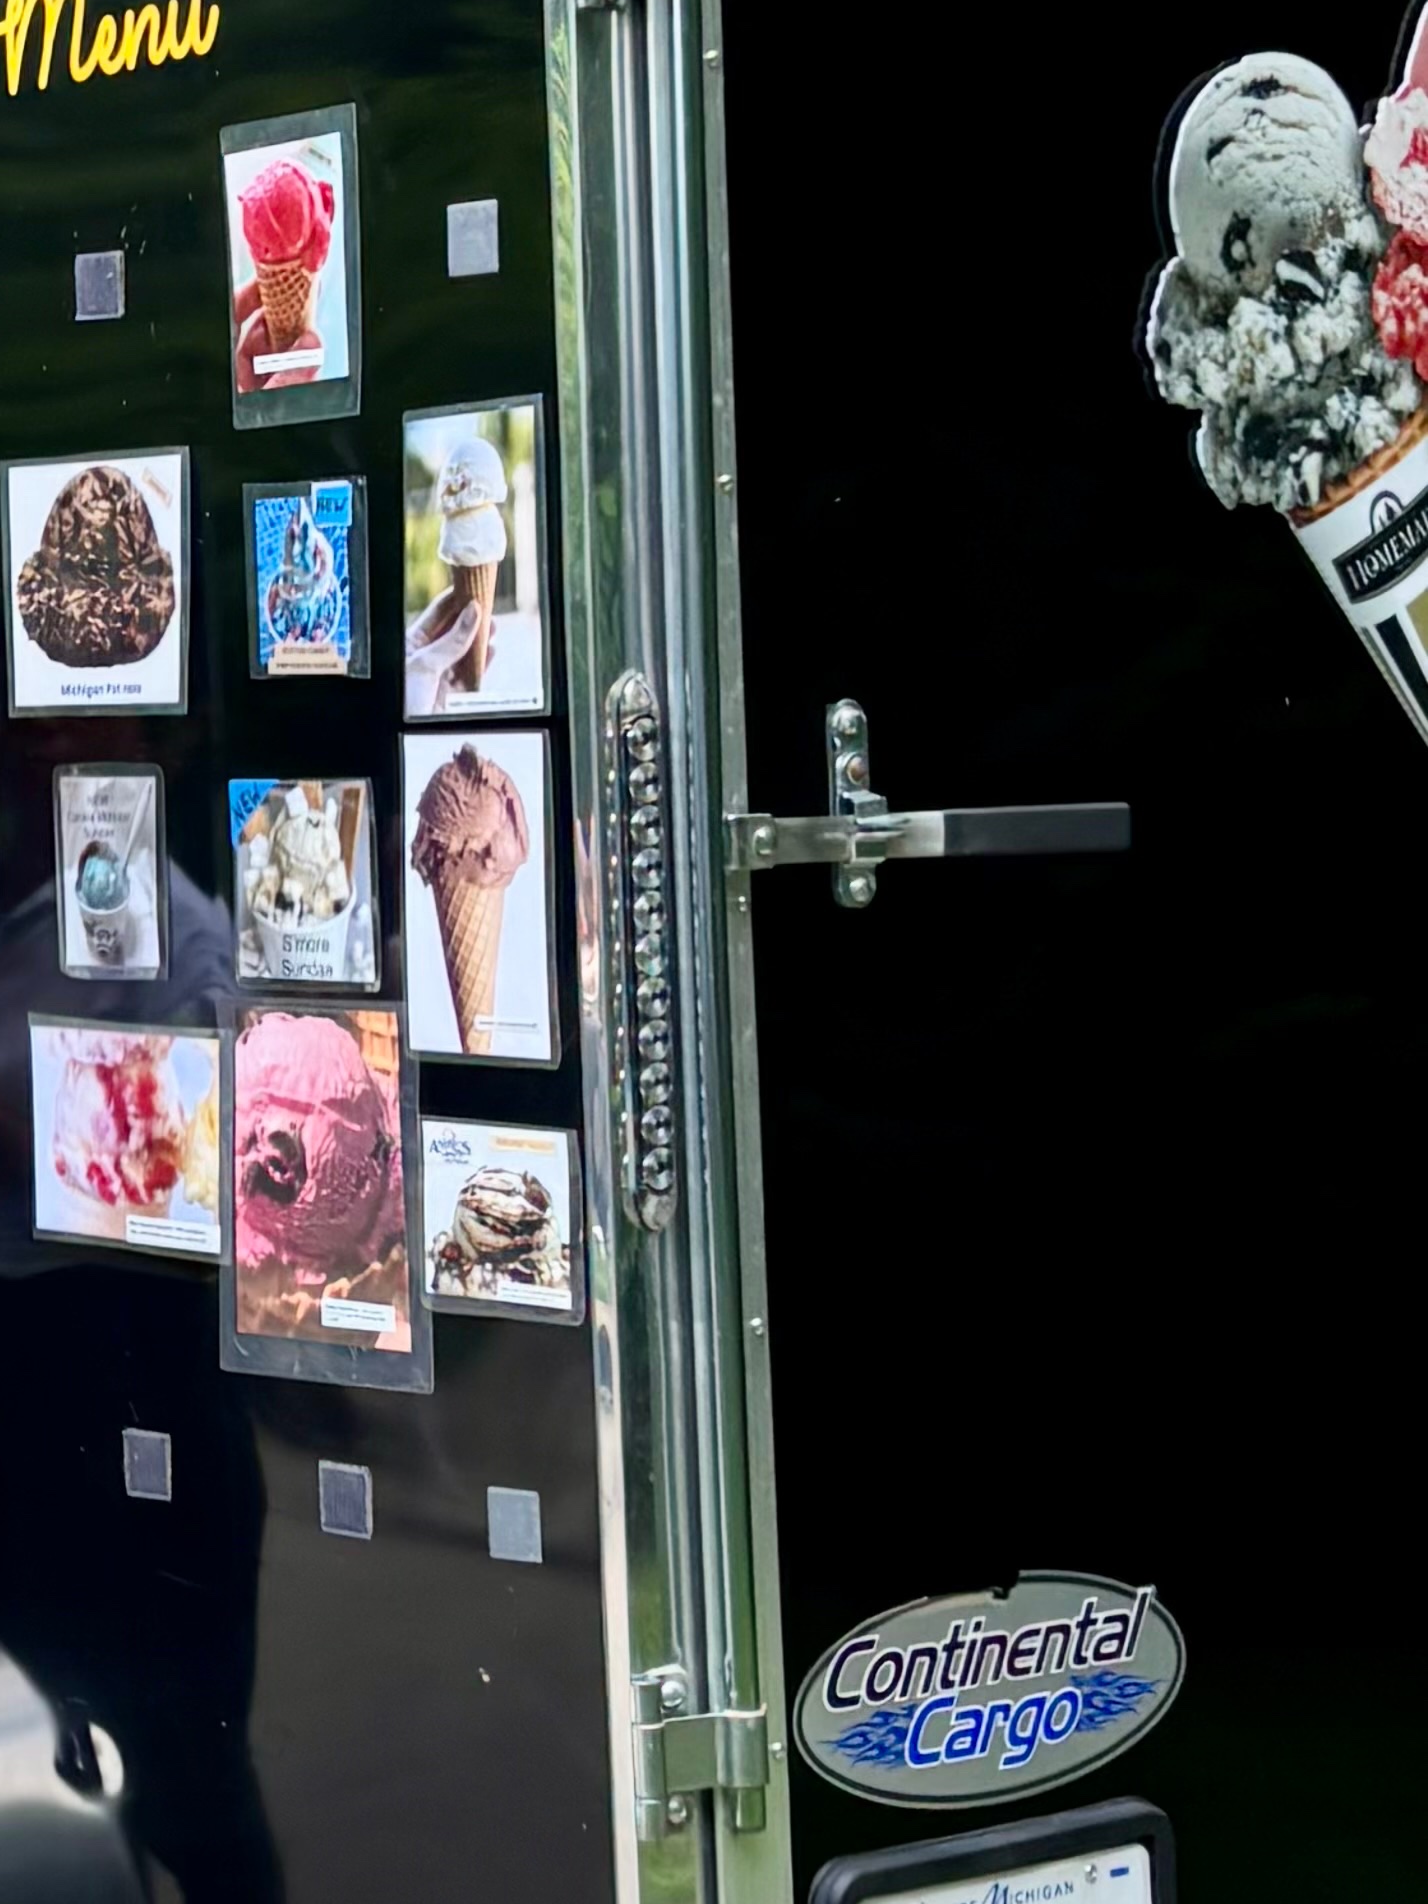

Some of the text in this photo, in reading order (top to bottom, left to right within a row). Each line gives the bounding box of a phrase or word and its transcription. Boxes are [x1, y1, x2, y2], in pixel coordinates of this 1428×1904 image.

[1346, 509, 1428, 591] HOMEMA
[824, 1587, 1153, 1711] Continental
[905, 1687, 1083, 1770] Cargo
